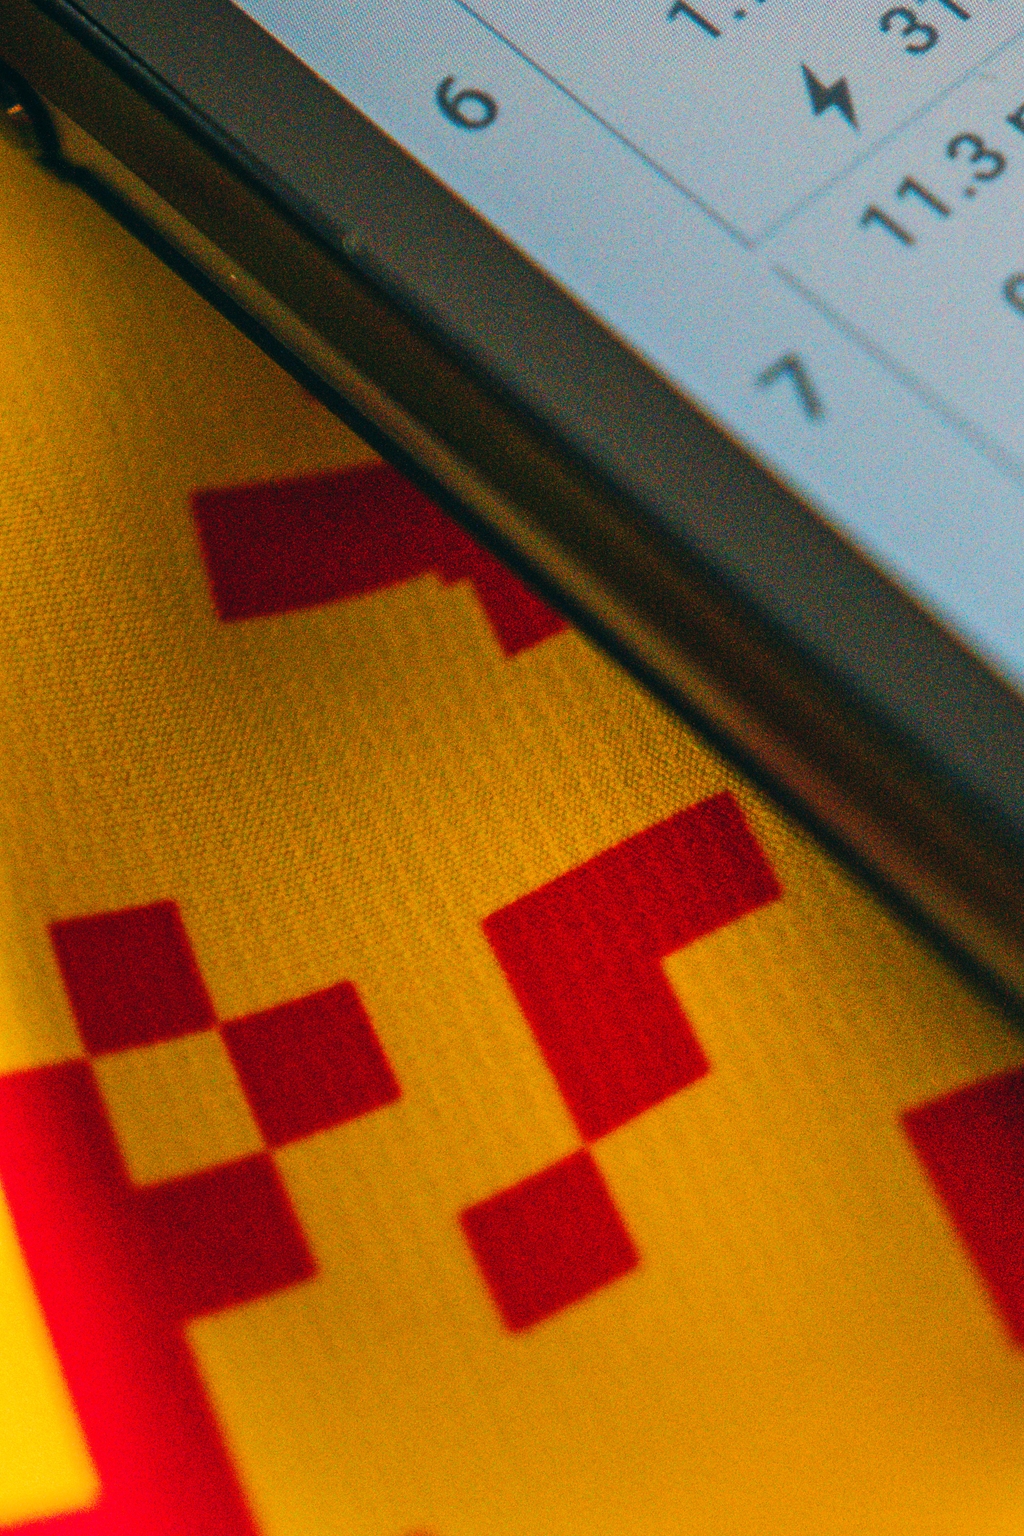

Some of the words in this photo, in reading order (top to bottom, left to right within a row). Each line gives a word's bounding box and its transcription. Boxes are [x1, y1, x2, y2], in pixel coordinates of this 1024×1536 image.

[434, 74, 499, 131] 6
[859, 132, 1008, 247] 11.3
[755, 351, 824, 421] 7
